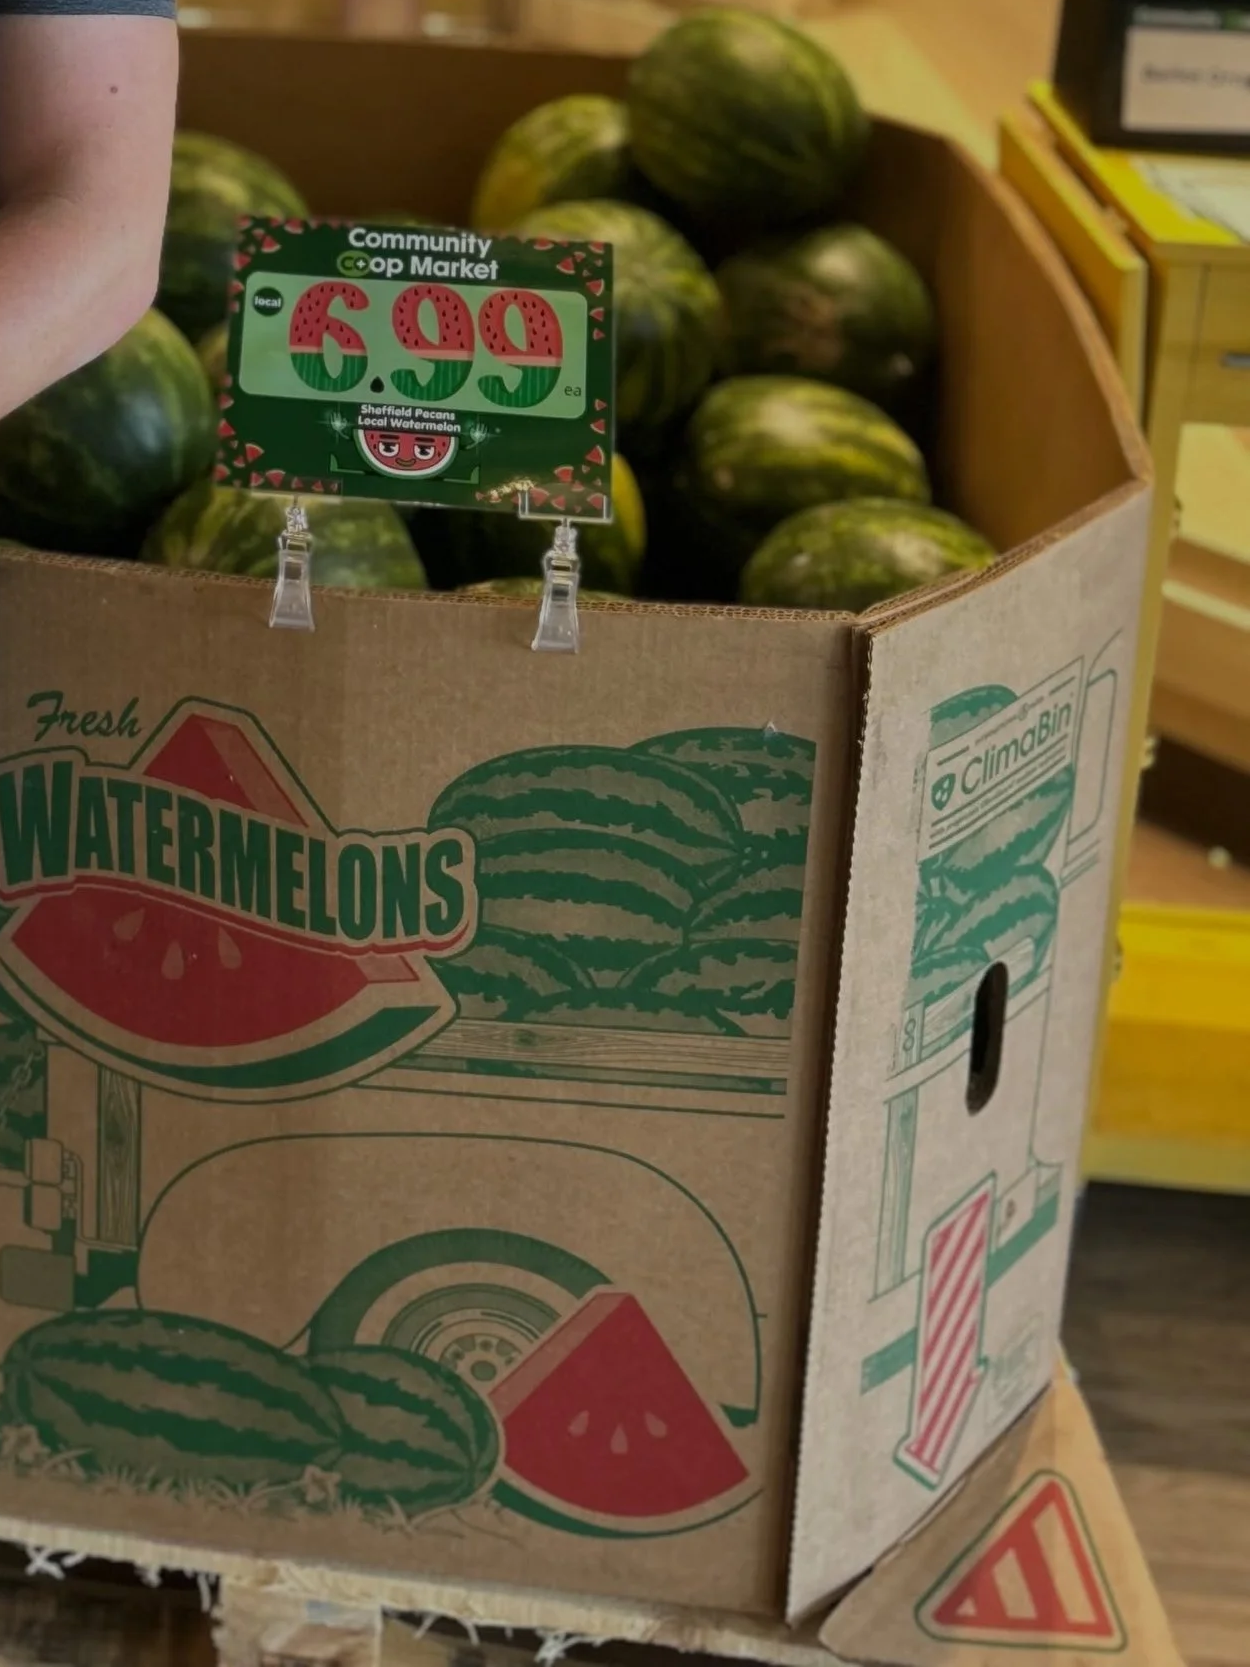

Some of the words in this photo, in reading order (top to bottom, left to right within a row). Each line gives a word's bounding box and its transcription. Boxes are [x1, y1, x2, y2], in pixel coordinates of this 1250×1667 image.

[348, 227, 492, 258] Community
[410, 255, 499, 280] Market
[254, 295, 282, 308] local
[289, 281, 564, 409] 6.99
[564, 385, 582, 397] ea
[357, 415, 388, 427] Local
[390, 418, 462, 433] Watermelon
[360, 404, 412, 417] Sheffield
[414, 408, 456, 421] Pecans
[26, 690, 145, 742] Fresh
[960, 700, 1072, 796] ClimaBin
